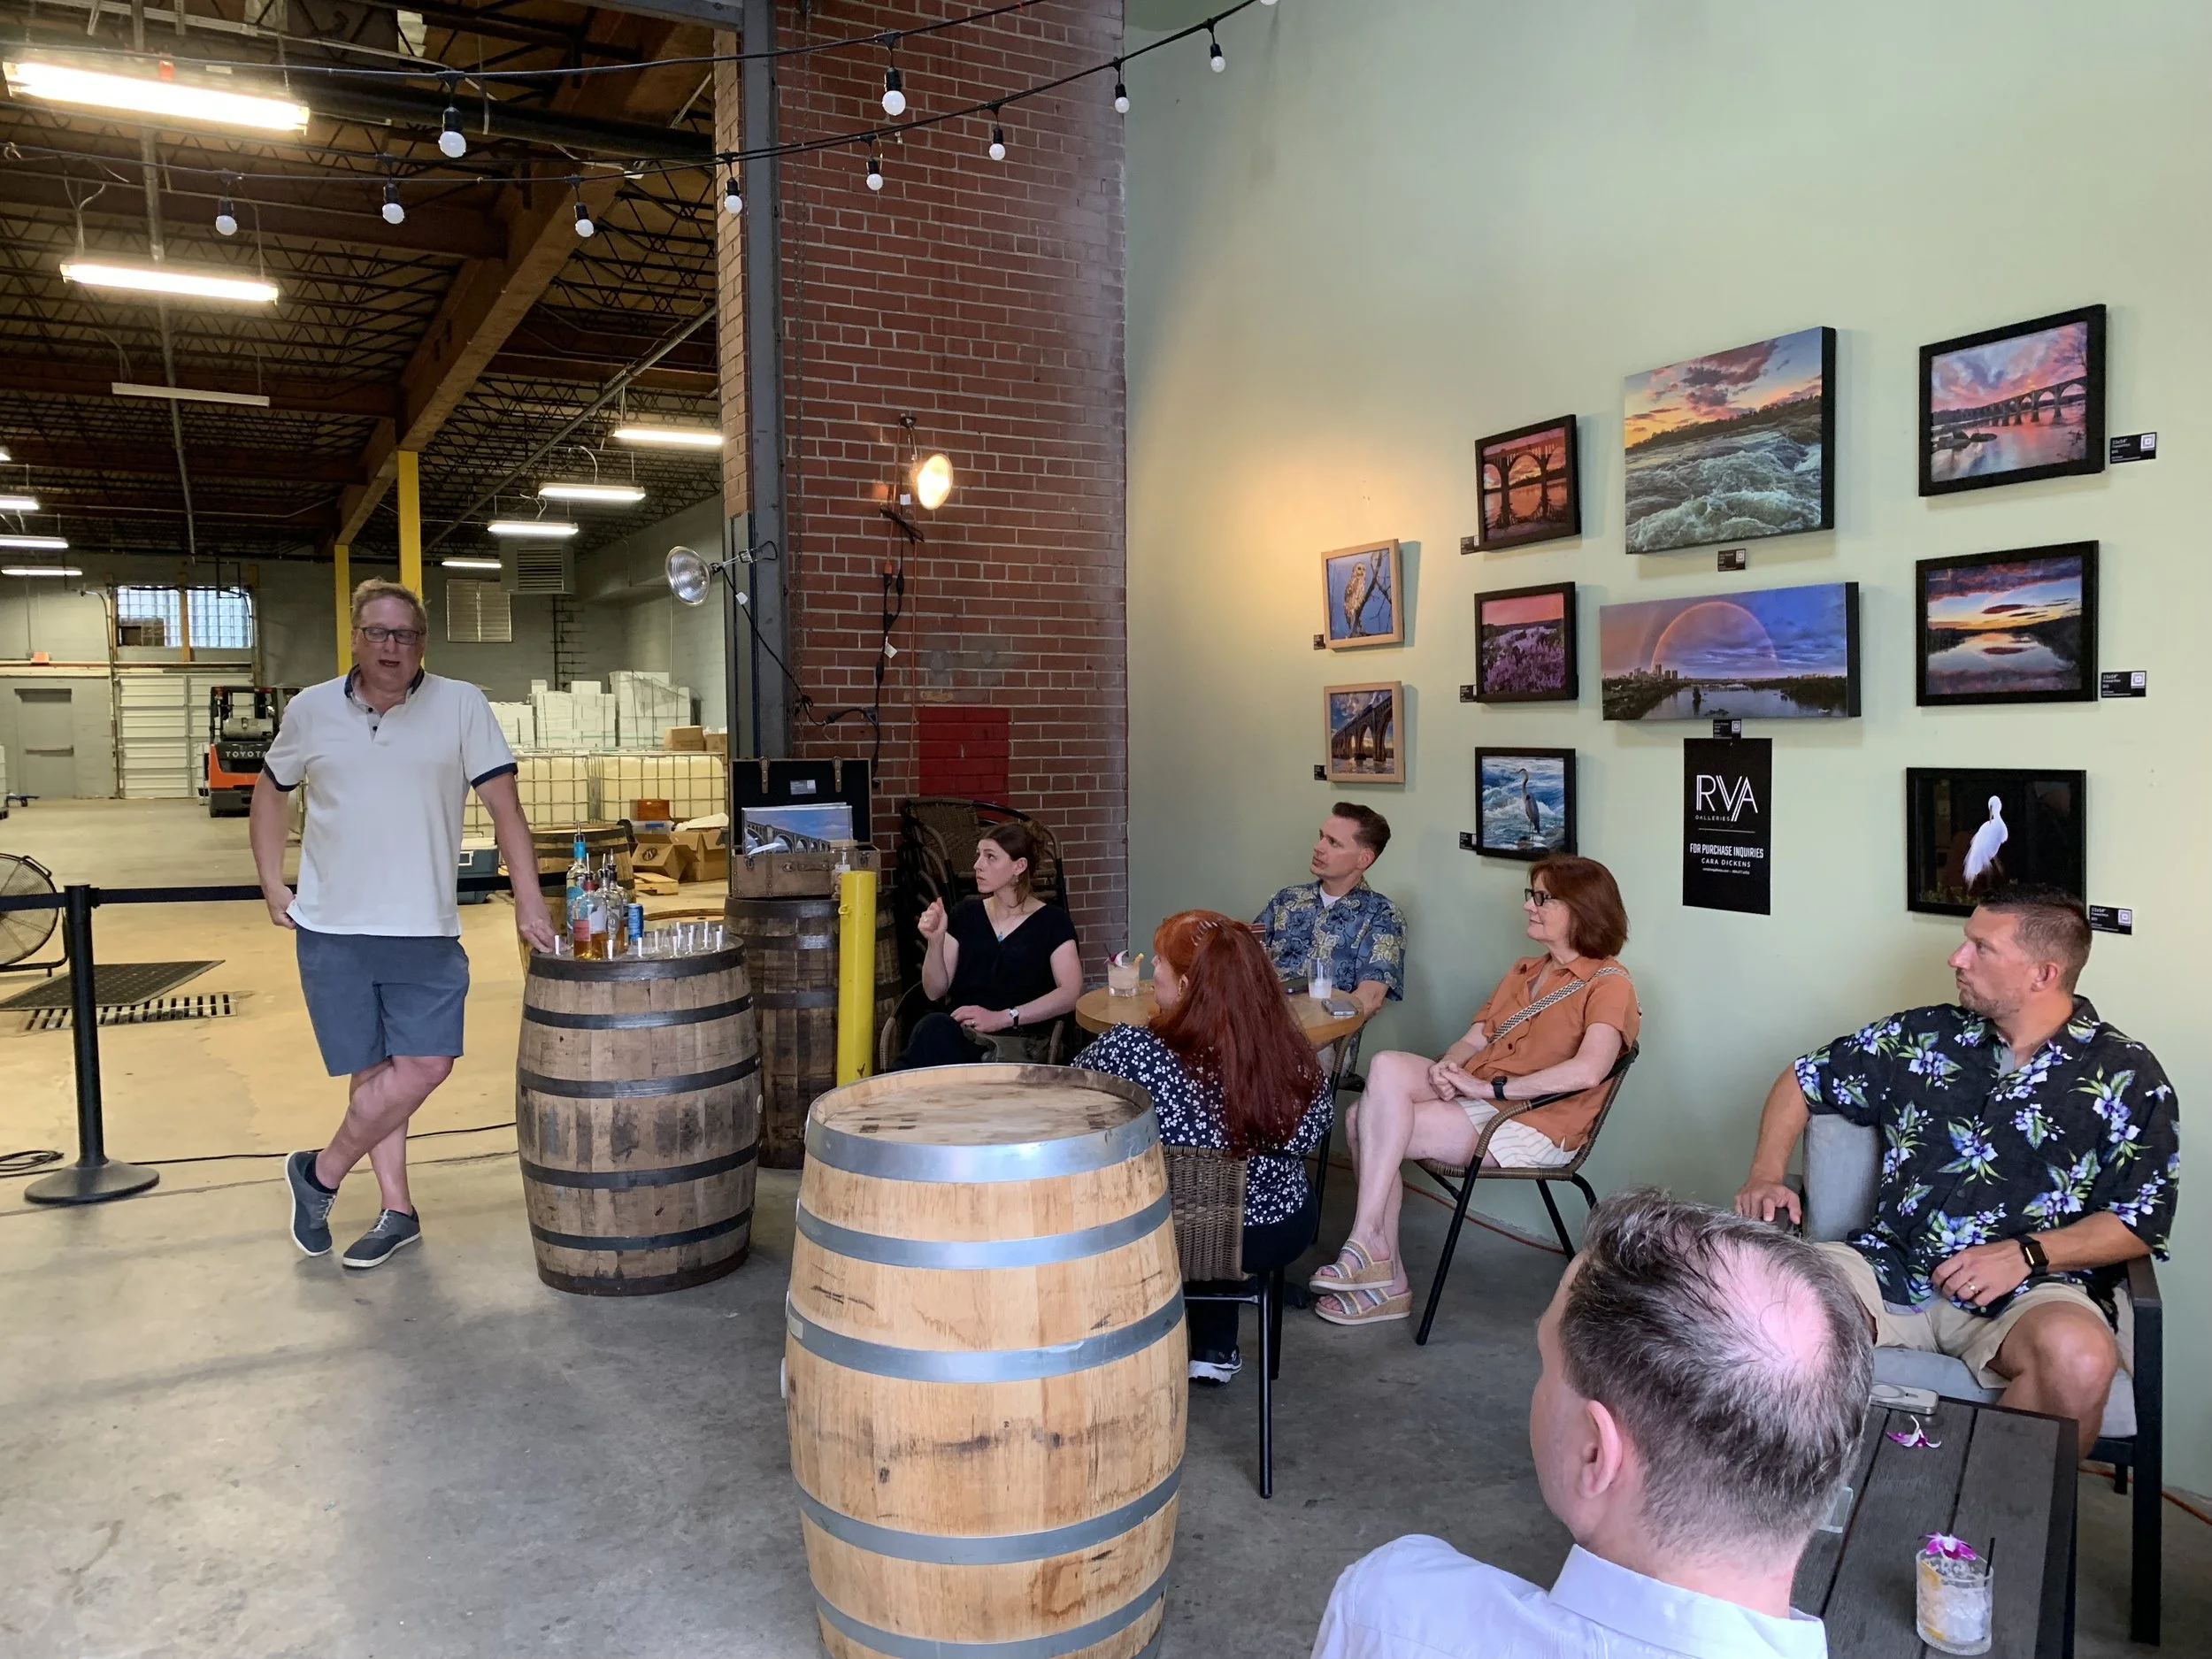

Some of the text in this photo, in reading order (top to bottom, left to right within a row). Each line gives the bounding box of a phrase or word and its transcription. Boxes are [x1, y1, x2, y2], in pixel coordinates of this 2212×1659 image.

[1695, 774, 1758, 822] RVA
[1690, 843, 1764, 858] FOR PURCHASE INQUIRIES
[1721, 859, 1751, 868] DICKENS
